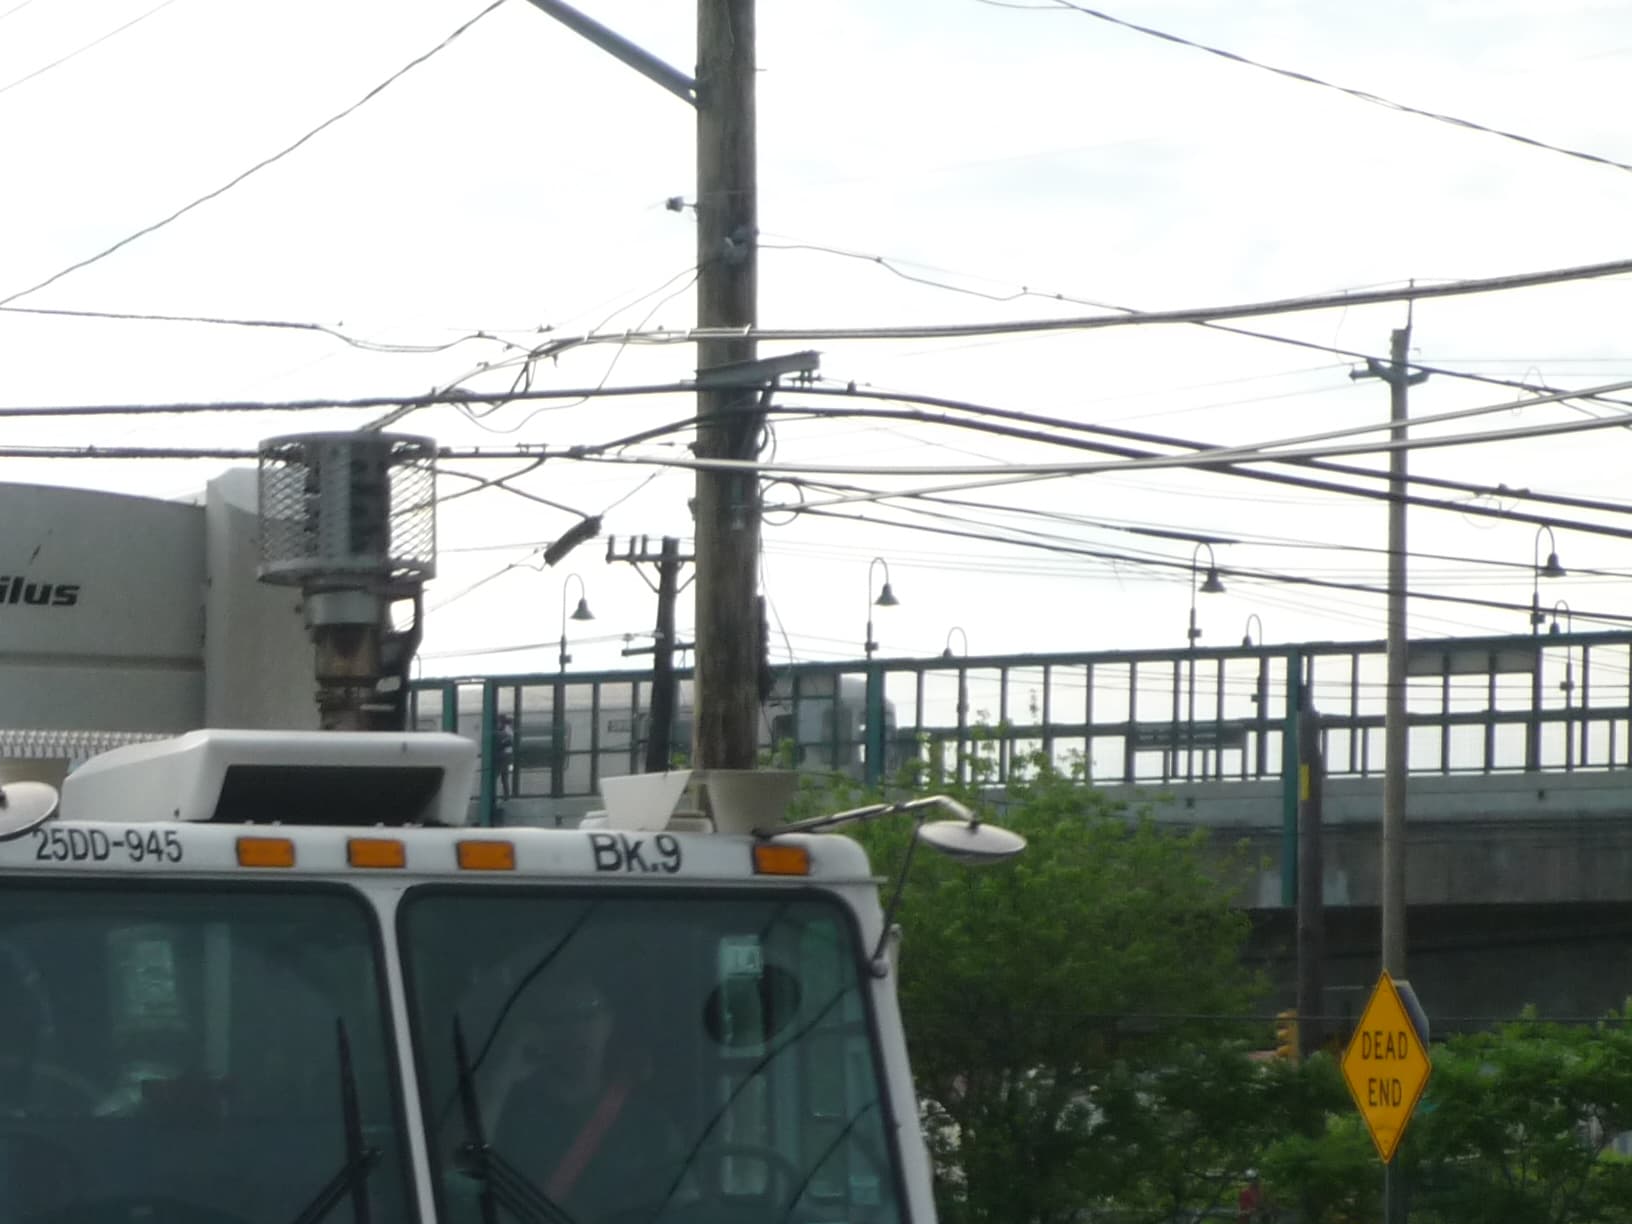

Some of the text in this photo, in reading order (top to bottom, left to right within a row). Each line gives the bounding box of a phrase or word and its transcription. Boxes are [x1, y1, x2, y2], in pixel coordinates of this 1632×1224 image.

[32, 827, 183, 863] 25DD-945
[1362, 1031, 1409, 1060] DEAD
[1368, 1078, 1402, 1107] END
